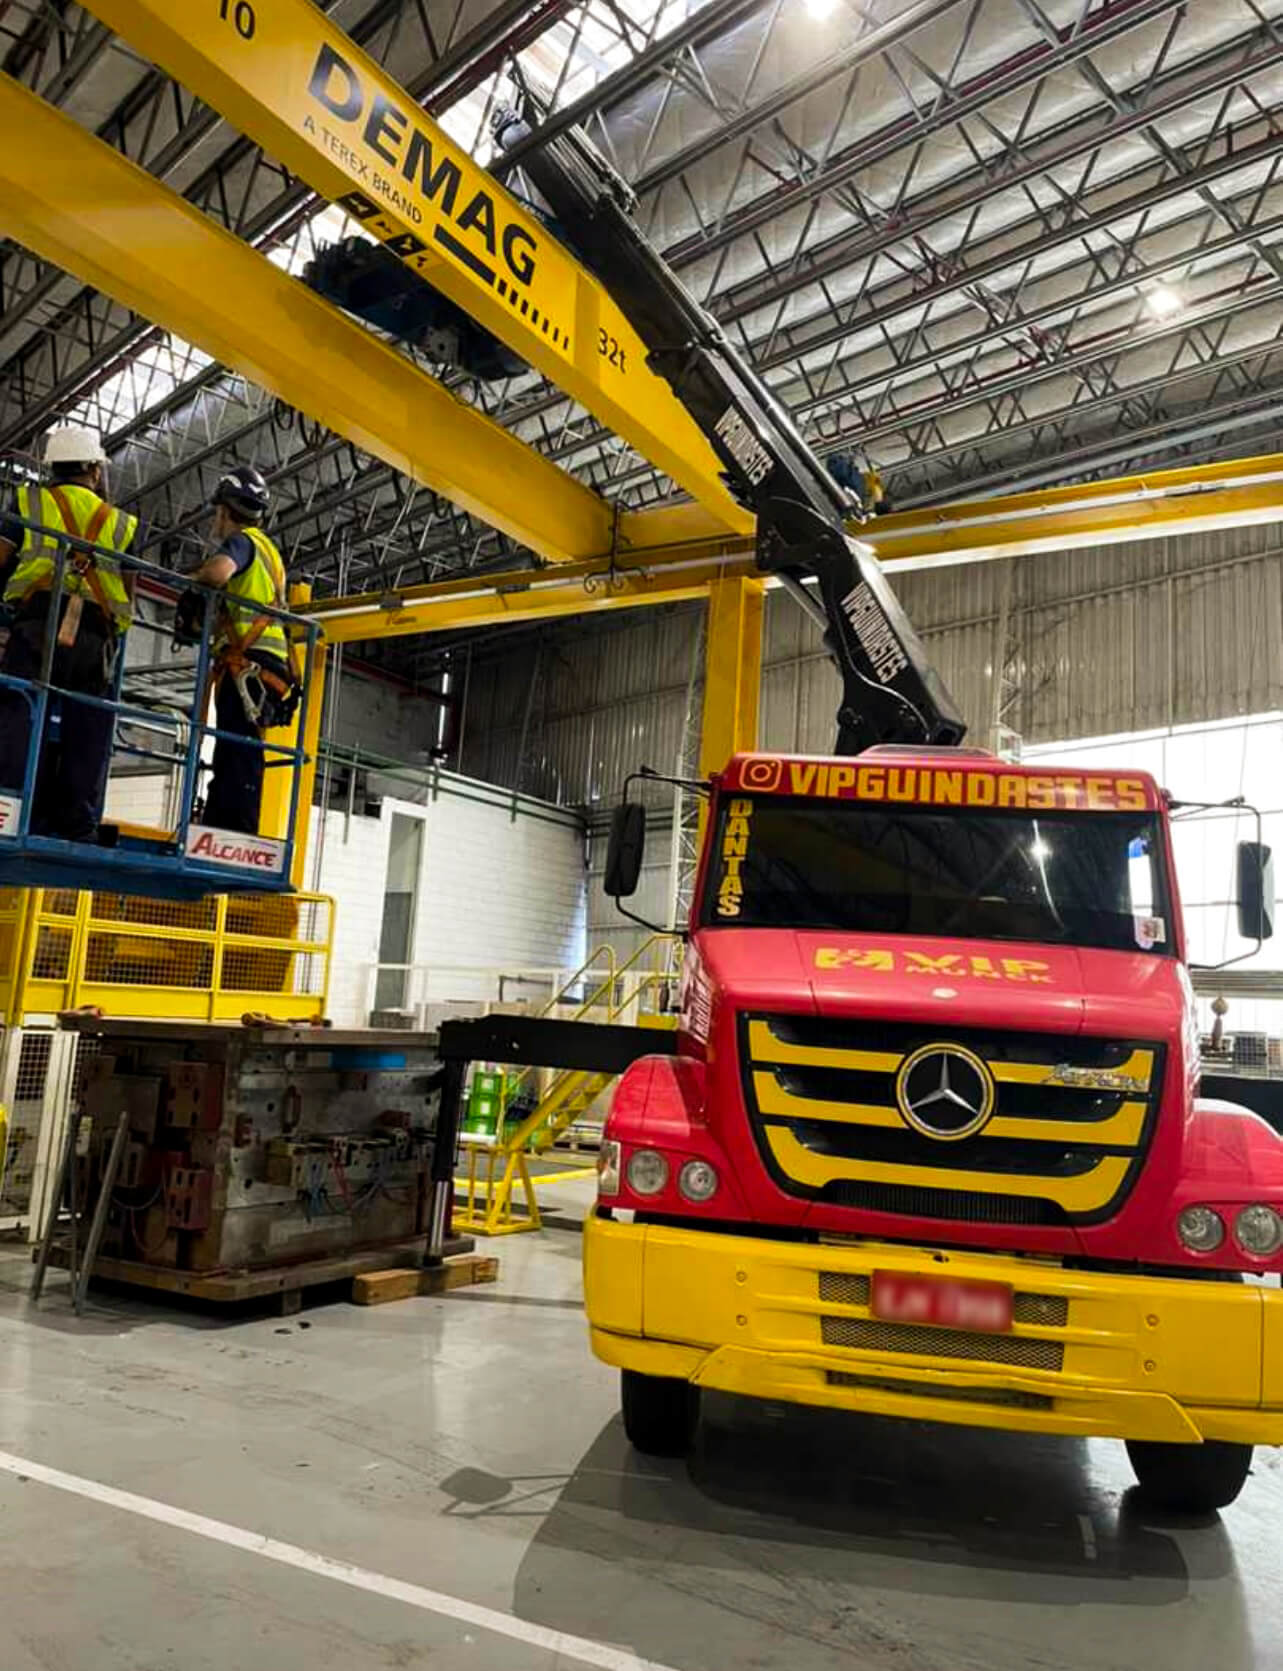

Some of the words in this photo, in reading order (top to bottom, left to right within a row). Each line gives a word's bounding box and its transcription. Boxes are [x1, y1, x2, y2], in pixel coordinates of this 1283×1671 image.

[304, 115, 316, 135] A
[320, 127, 368, 180] TEREX
[371, 172, 423, 224] BRAND
[307, 42, 538, 287] DEMAG
[598, 327, 626, 374] 32t
[789, 763, 1147, 811] VIPGUINDASTES
[191, 831, 277, 867] ALCANCE
[716, 799, 753, 917] DANTAS
[903, 951, 1050, 977] VIP
